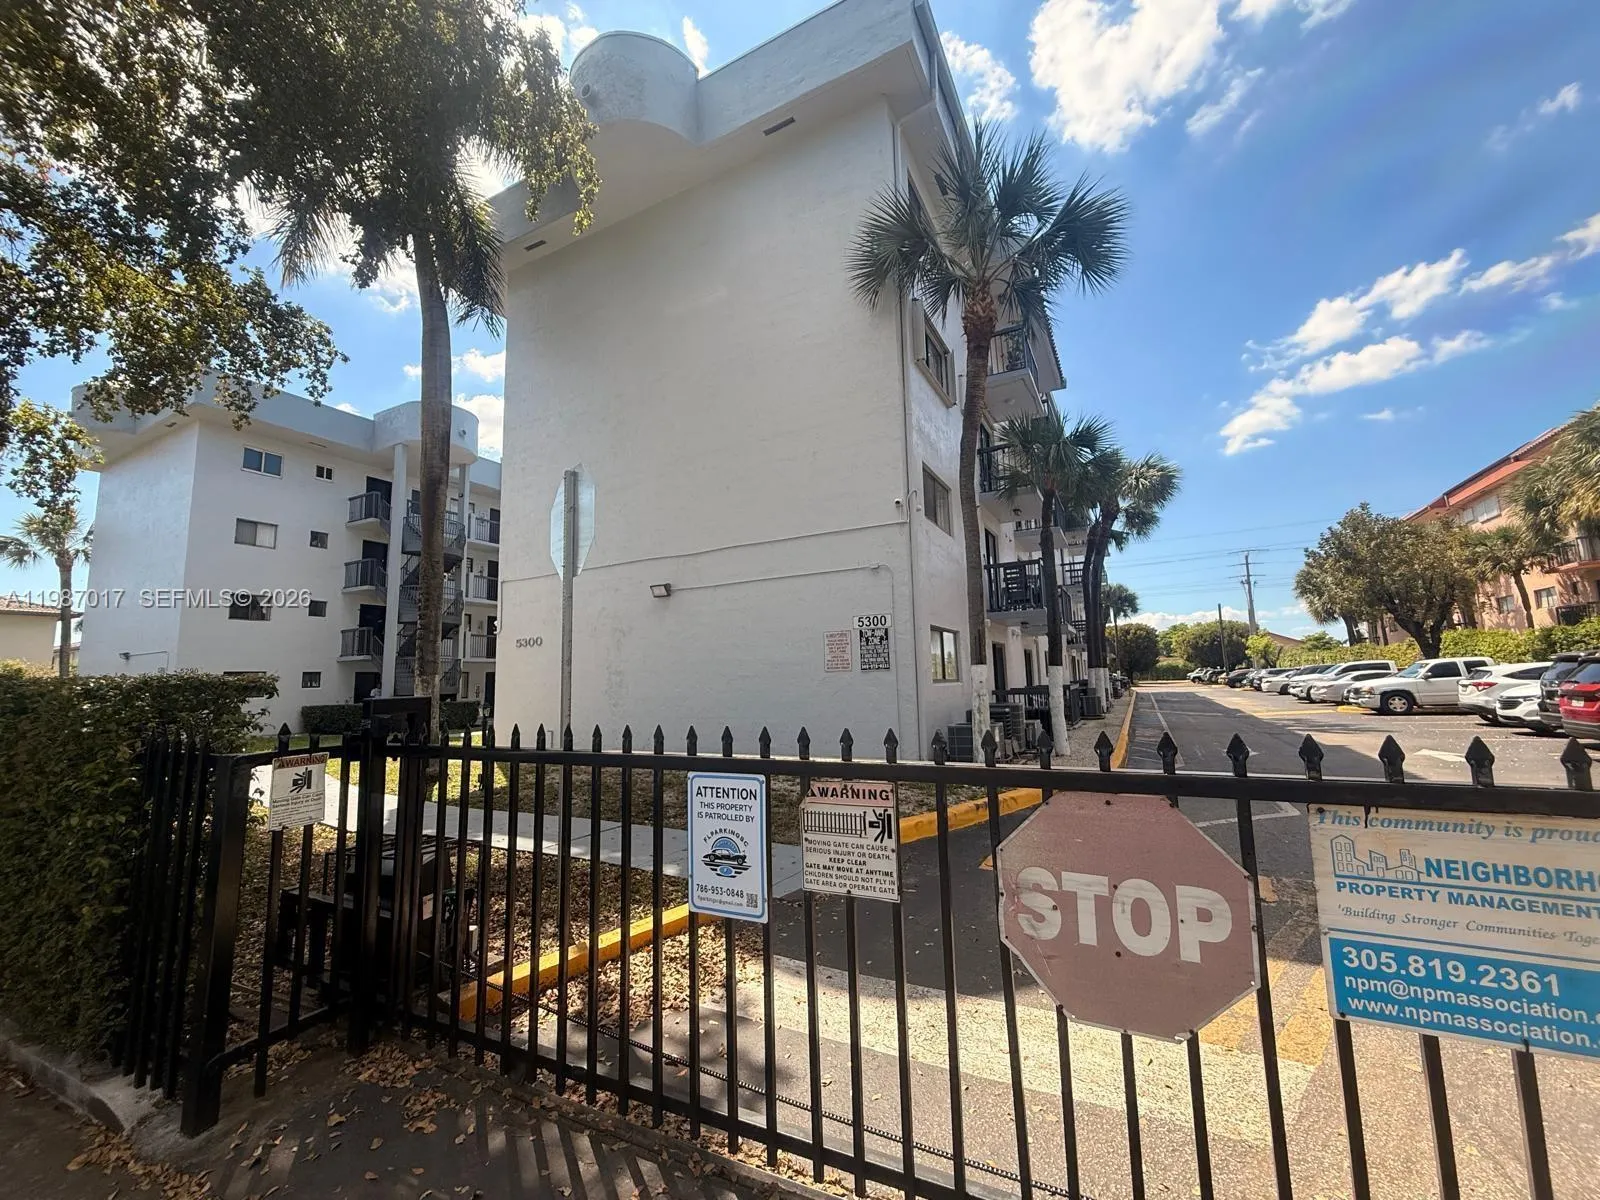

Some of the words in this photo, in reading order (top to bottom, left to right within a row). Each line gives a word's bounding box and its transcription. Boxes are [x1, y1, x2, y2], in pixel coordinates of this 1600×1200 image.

[857, 615, 887, 628] 5300
[515, 636, 543, 648] 5300
[285, 754, 327, 767] WARNING
[696, 785, 757, 801] ATTENTION
[817, 786, 890, 801] WARNING
[699, 801, 715, 810] THIS
[716, 802, 753, 812] PROPERTY
[697, 811, 704, 819] IS
[705, 812, 744, 822] PATROLLED
[745, 815, 755, 823] BY
[1317, 808, 1361, 827] This
[1368, 816, 1496, 840] community
[1504, 820, 1523, 838] is
[805, 846, 831, 855] SERIOUS
[832, 849, 855, 857] INJURY
[807, 839, 831, 847] MOVING
[833, 841, 849, 849] GATE
[866, 844, 888, 852] CAUSE
[846, 858, 867, 866] CLEAR
[804, 870, 833, 879] CHILDREN
[834, 873, 859, 882] SHOULD
[822, 863, 835, 871] MAY
[836, 865, 853, 873] MOVE
[865, 869, 894, 877] ANYTIME
[1424, 856, 1600, 893] NEIGHBORH
[696, 883, 745, 899] 786-953-0848
[821, 879, 837, 888] AREA
[848, 883, 877, 892] OPERATE
[878, 886, 896, 894] GATE
[1336, 880, 1440, 903] PROPERTY
[1447, 891, 1600, 920] MANAGEMENT
[1016, 866, 1233, 964] STOP
[1401, 912, 1459, 931] Stronger
[1465, 919, 1558, 940] Communities
[1342, 946, 1560, 997] 305.819.2361
[1347, 997, 1600, 1049] www.npmassociation.
